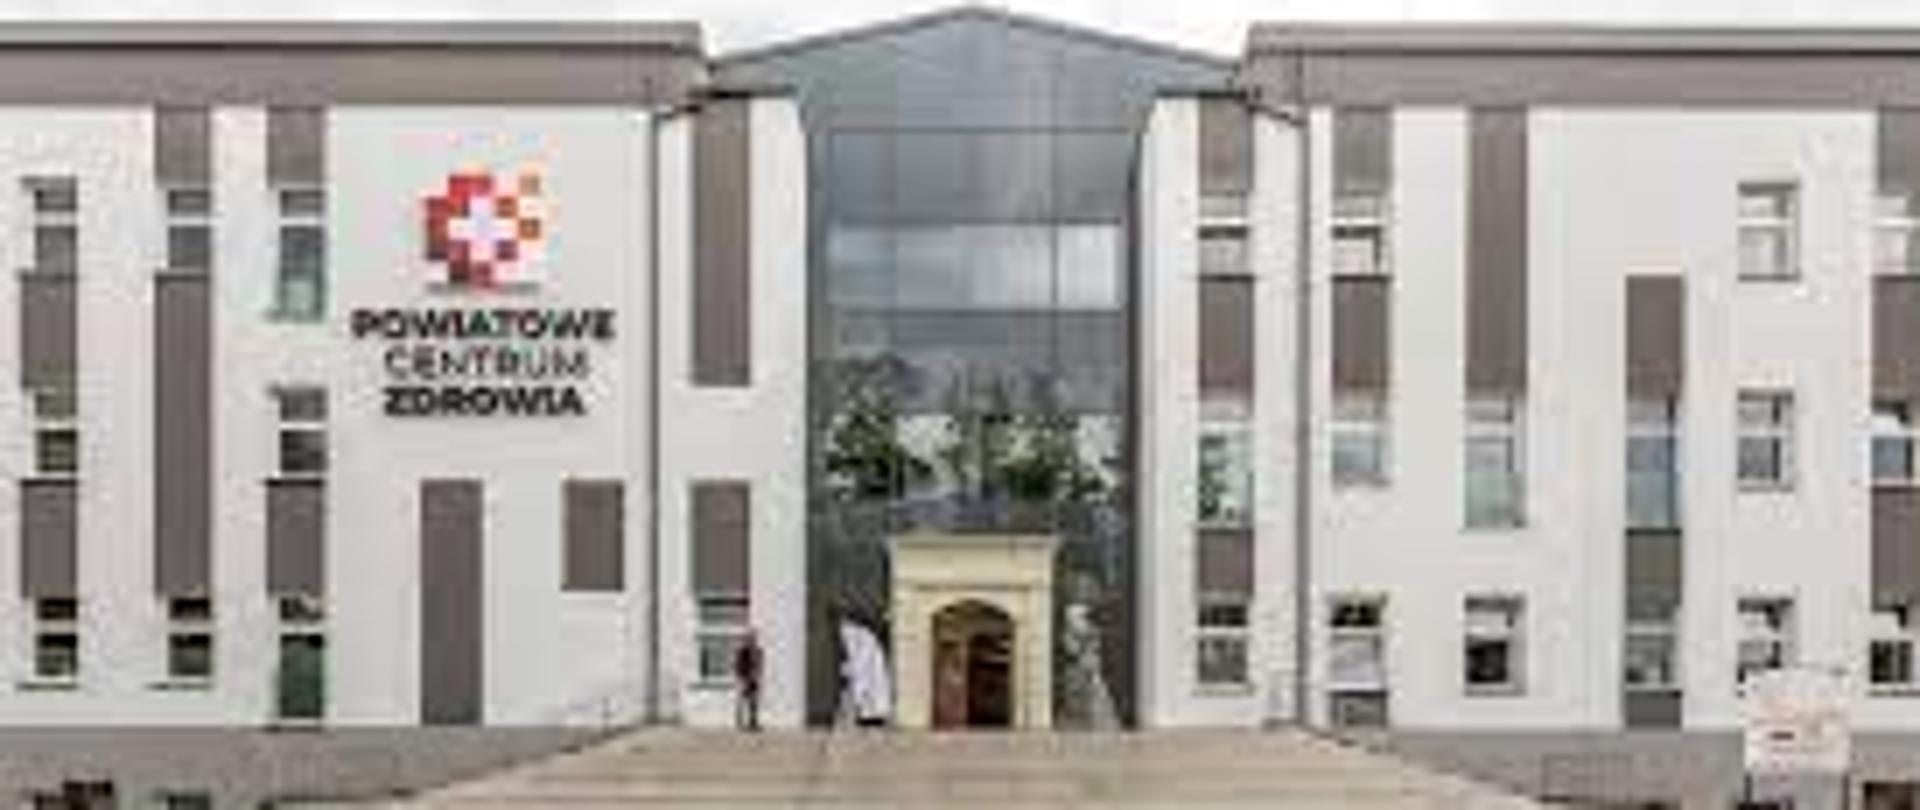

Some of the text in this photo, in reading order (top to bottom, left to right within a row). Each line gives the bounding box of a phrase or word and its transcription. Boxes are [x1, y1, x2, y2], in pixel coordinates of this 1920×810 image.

[351, 309, 616, 339] POWIATOWE
[384, 347, 590, 379] CENTRUM
[383, 386, 586, 416] ZDROWIA
